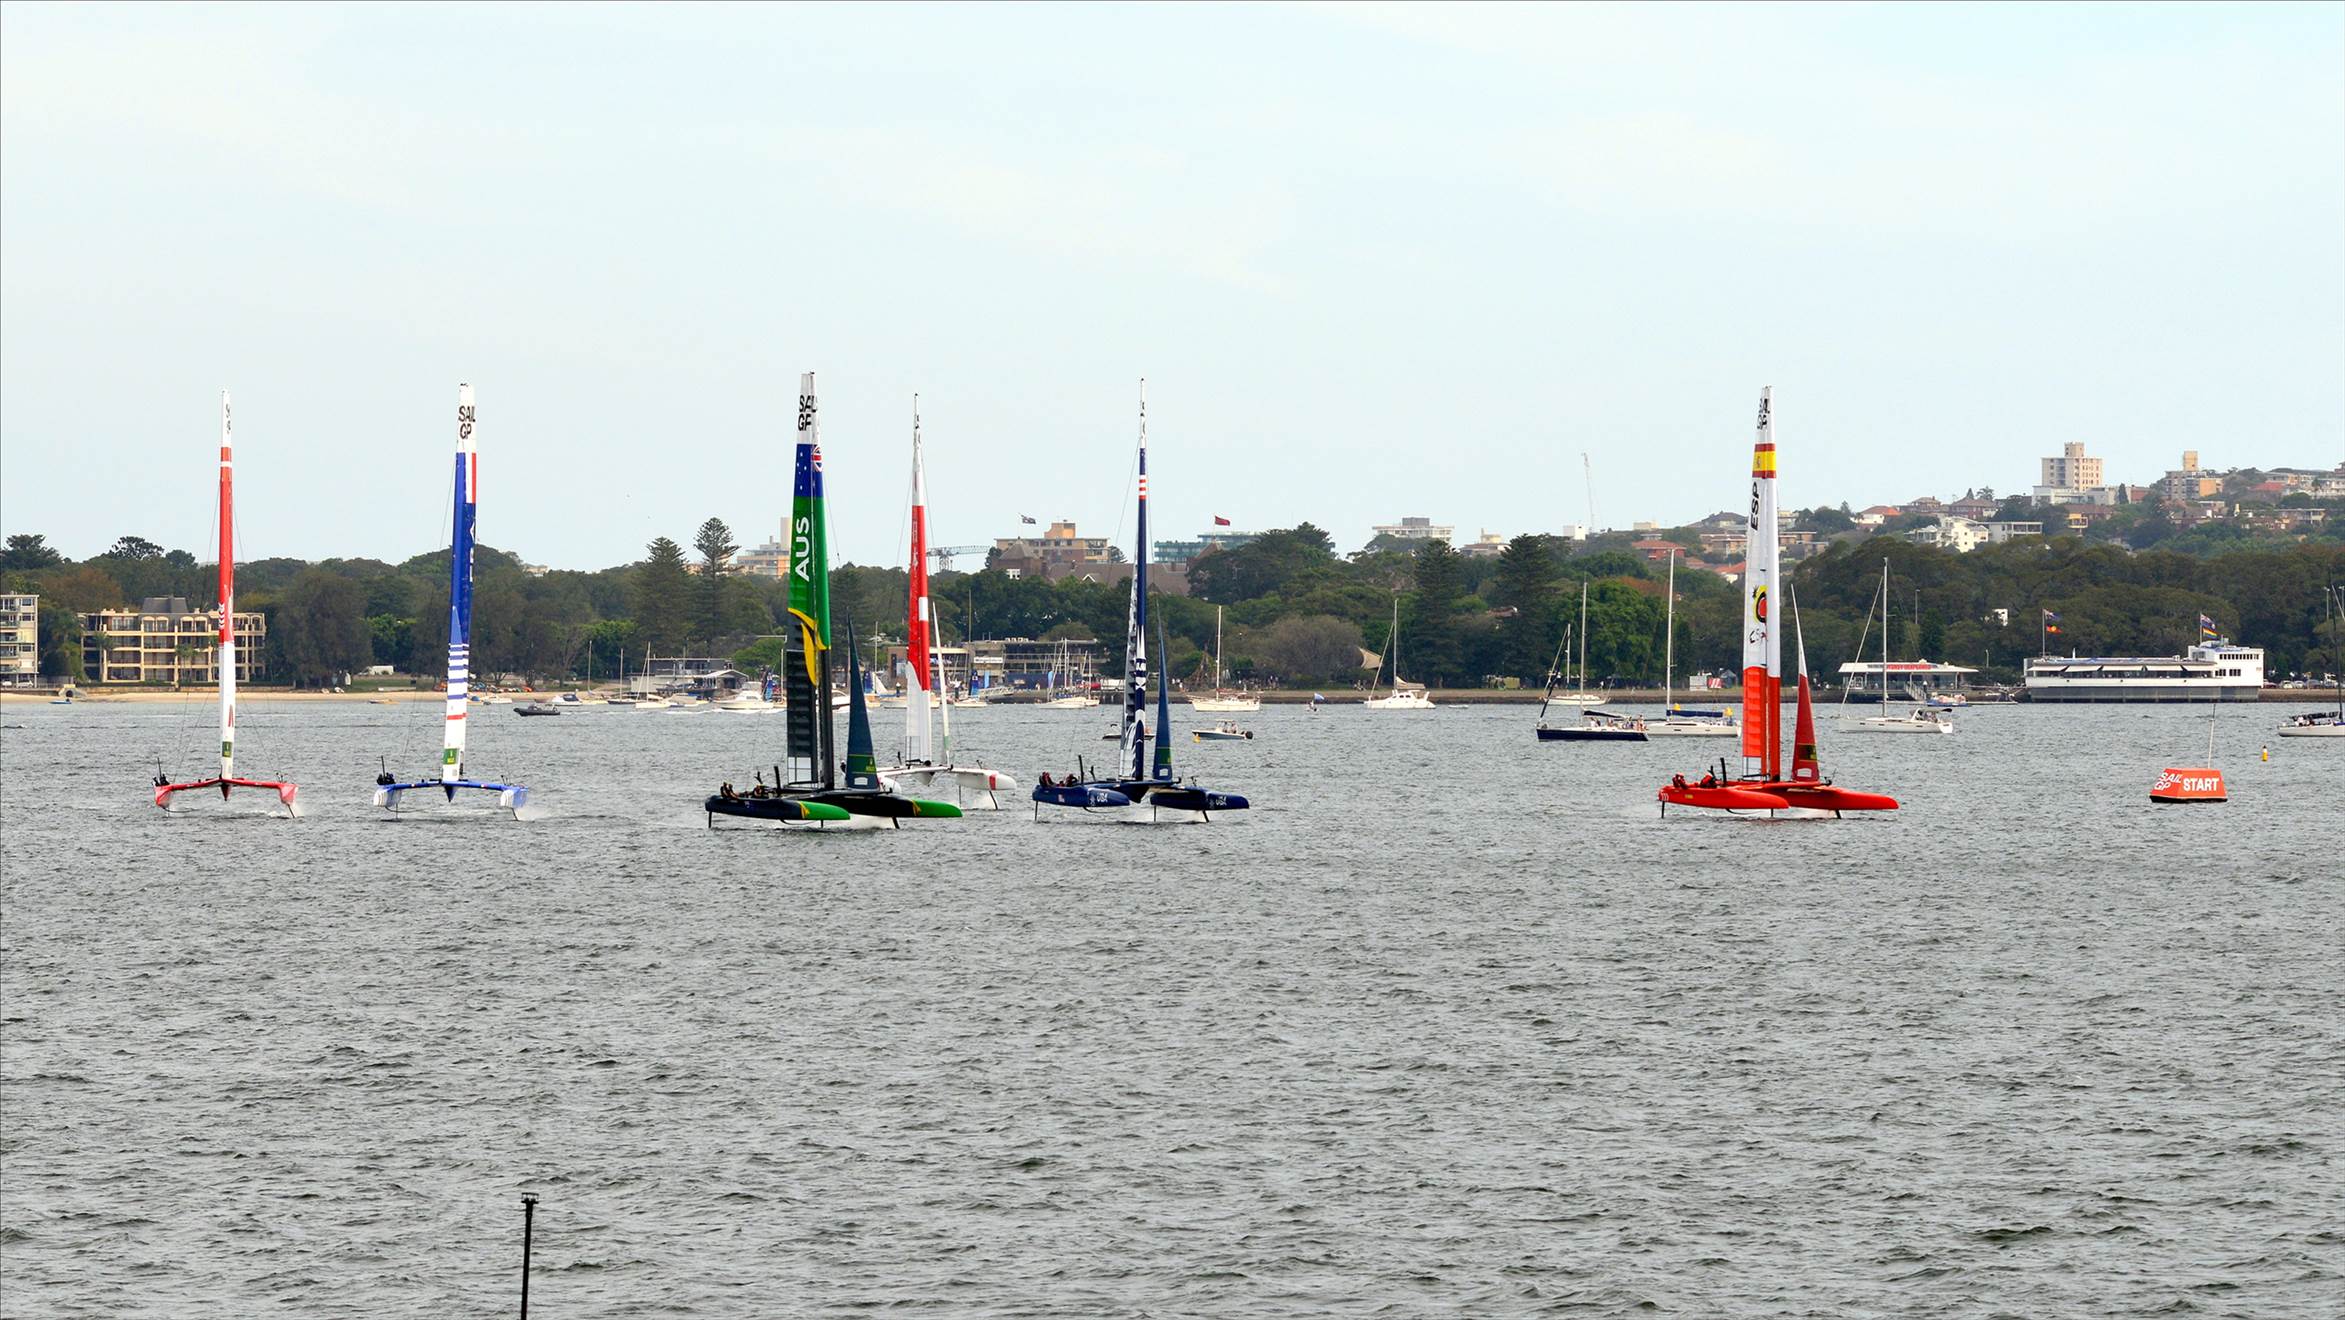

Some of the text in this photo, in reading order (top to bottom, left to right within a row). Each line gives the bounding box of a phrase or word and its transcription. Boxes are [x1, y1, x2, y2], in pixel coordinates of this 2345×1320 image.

[460, 422, 472, 440] GP
[1750, 481, 1760, 531] ESP
[795, 516, 810, 582] AUS
[2159, 772, 2183, 783] SAIL
[2183, 777, 2220, 792] START
[2154, 781, 2172, 791] GP
